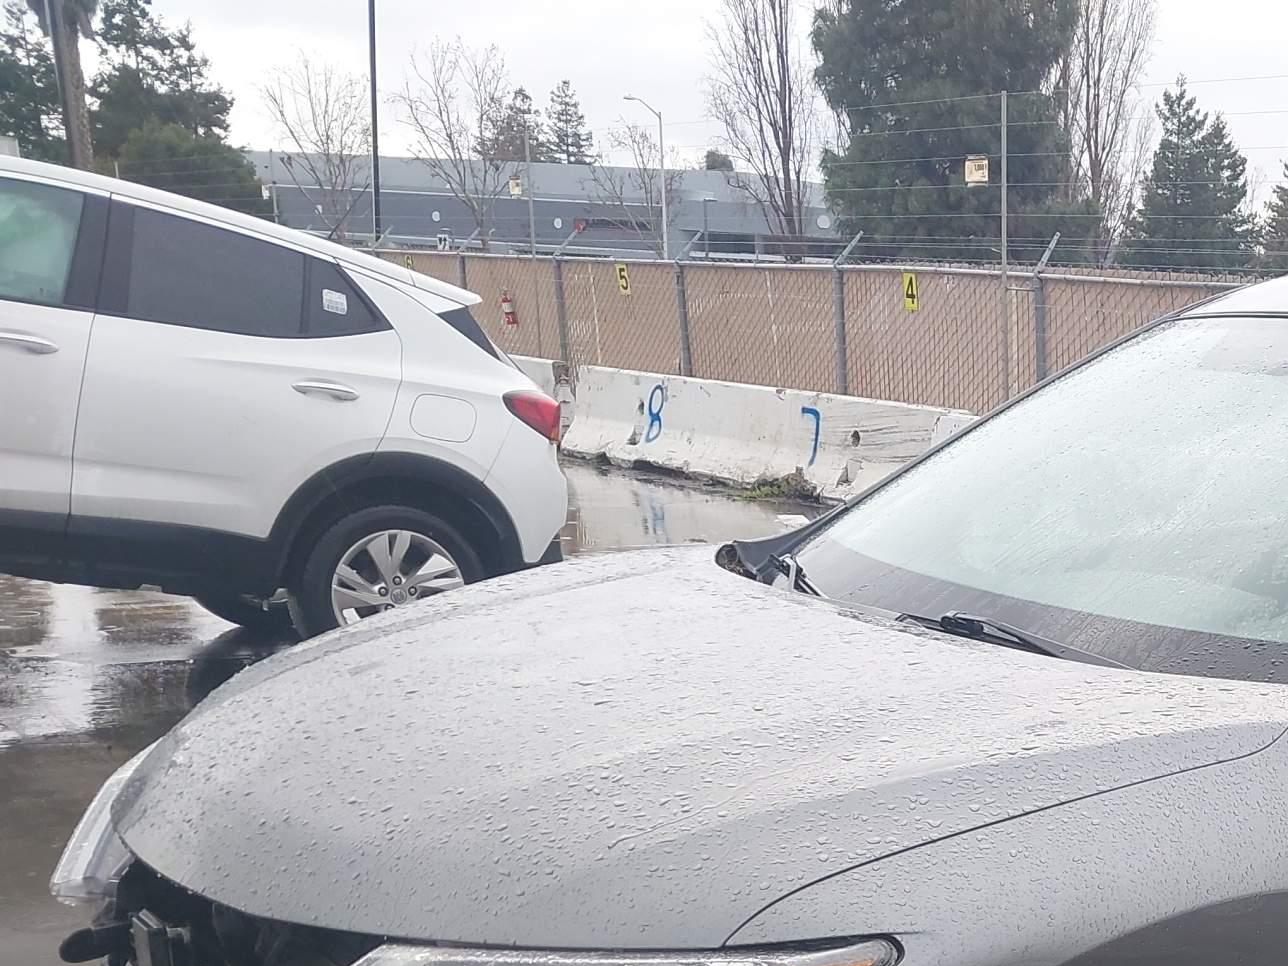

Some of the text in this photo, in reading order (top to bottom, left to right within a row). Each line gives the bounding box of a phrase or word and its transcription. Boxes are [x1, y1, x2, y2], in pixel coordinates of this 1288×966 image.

[618, 267, 629, 291] 5
[905, 276, 916, 305] 4
[644, 384, 664, 443] 8
[802, 406, 820, 466] 7
